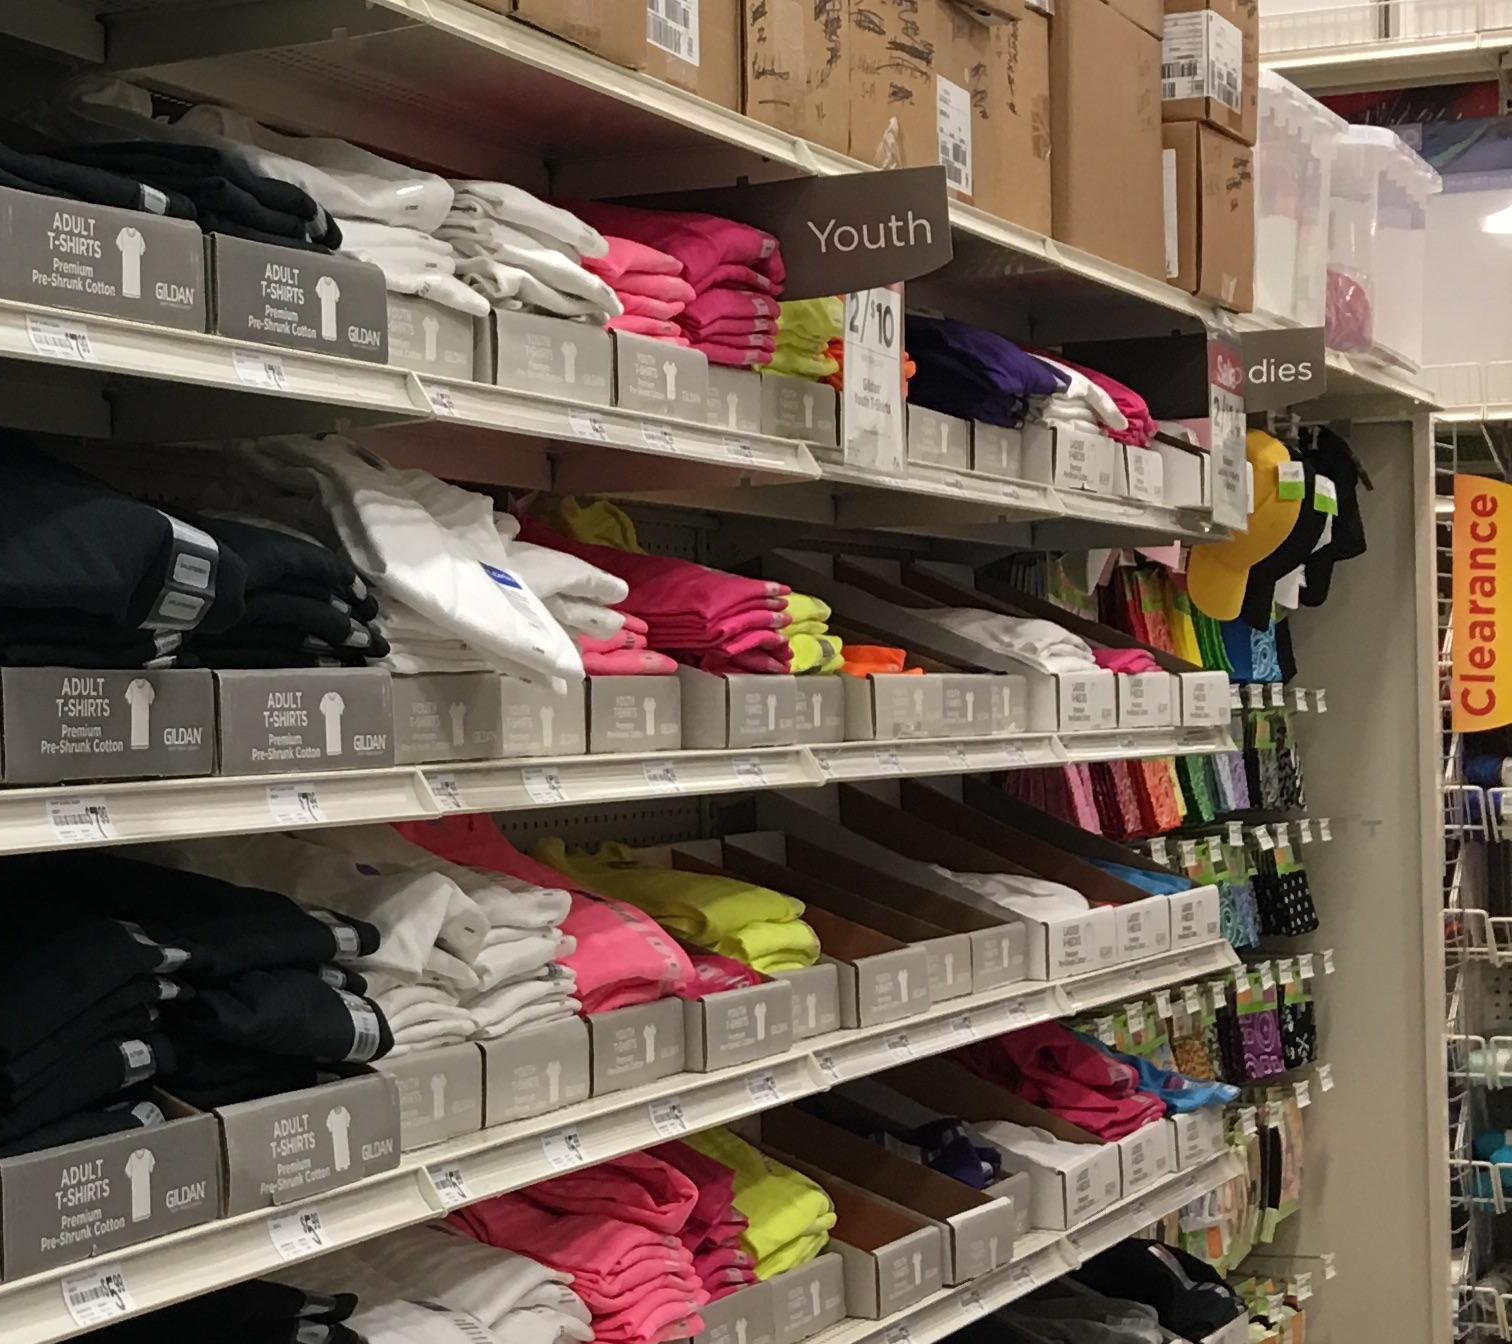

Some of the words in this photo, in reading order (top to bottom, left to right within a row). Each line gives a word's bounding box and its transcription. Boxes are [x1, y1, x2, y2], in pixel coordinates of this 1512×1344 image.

[52, 211, 97, 238] ADULT
[807, 210, 933, 254] Youth
[46, 231, 102, 260] T-SHIRTS
[155, 280, 196, 306] GILDAN
[1247, 358, 1314, 384] dies
[1461, 492, 1499, 717] Clearance
[60, 676, 107, 698] ADULT
[55, 695, 112, 718] T-SHIRTS
[162, 725, 205, 748] GILDAN
[273, 1112, 310, 1140] ADULT
[269, 1129, 317, 1159] T-SHIRTS
[361, 1137, 395, 1162] GILDAN
[60, 1158, 105, 1190] ADULT
[54, 1177, 111, 1211] T-SHIRTS
[165, 1179, 208, 1211] GILDAN
